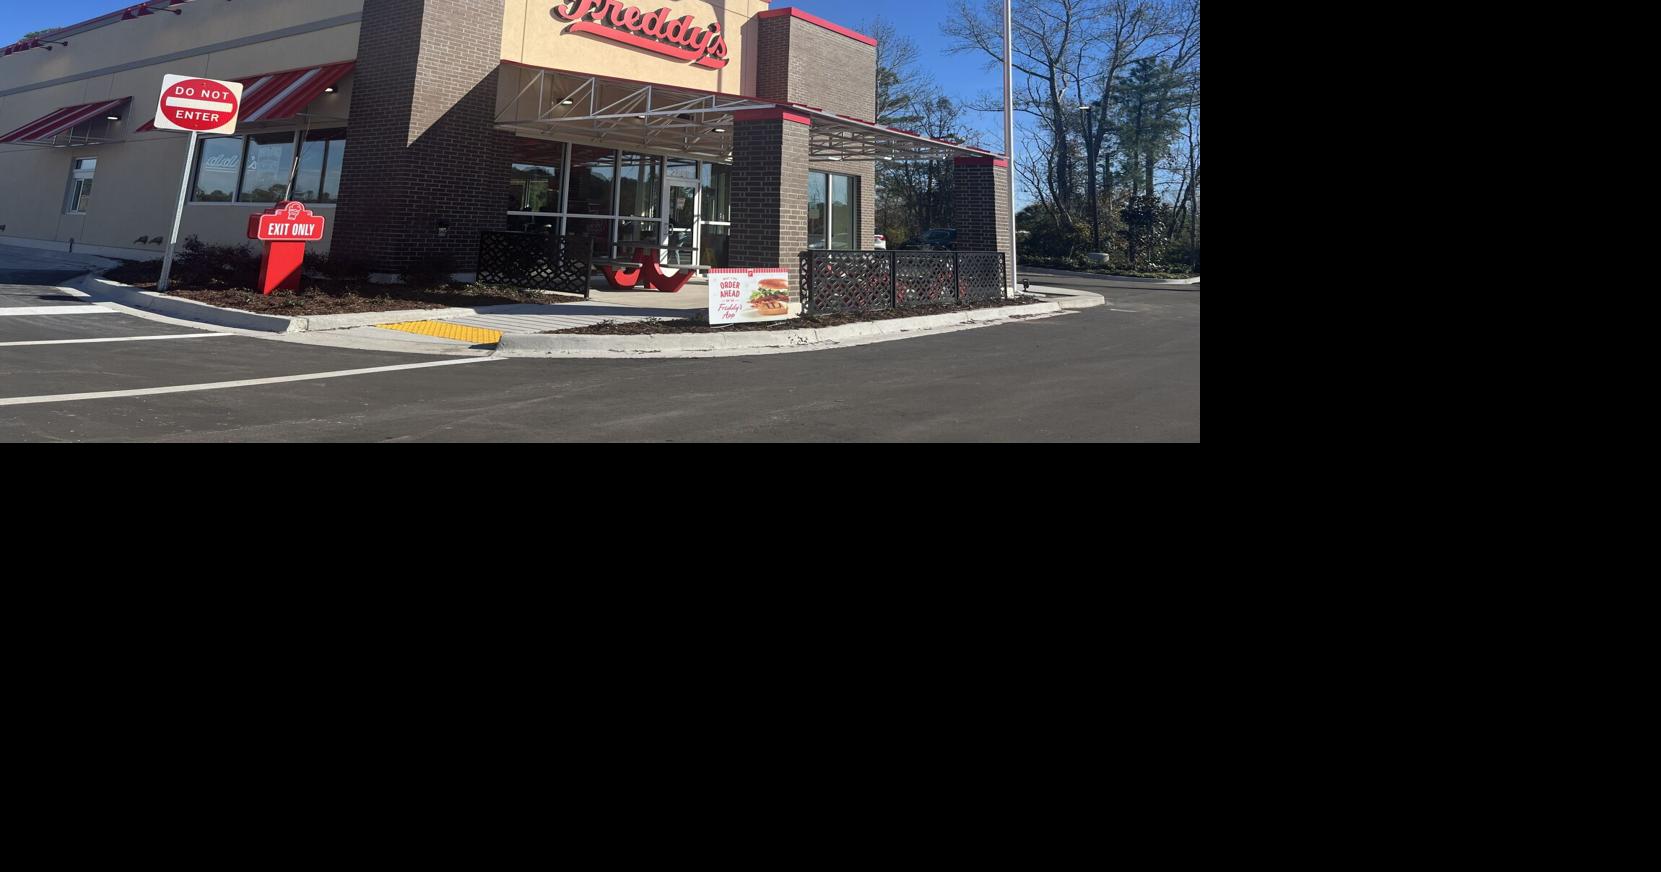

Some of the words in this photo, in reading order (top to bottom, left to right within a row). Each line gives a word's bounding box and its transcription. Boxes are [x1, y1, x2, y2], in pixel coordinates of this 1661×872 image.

[175, 86, 195, 96] DO
[201, 90, 229, 100] NOT
[175, 110, 220, 122] ENTER
[268, 223, 290, 236] EXIT
[291, 223, 315, 236] ONLY
[720, 290, 740, 298] AHEAD
[718, 303, 742, 312] Freddy's
[722, 311, 735, 319] App
